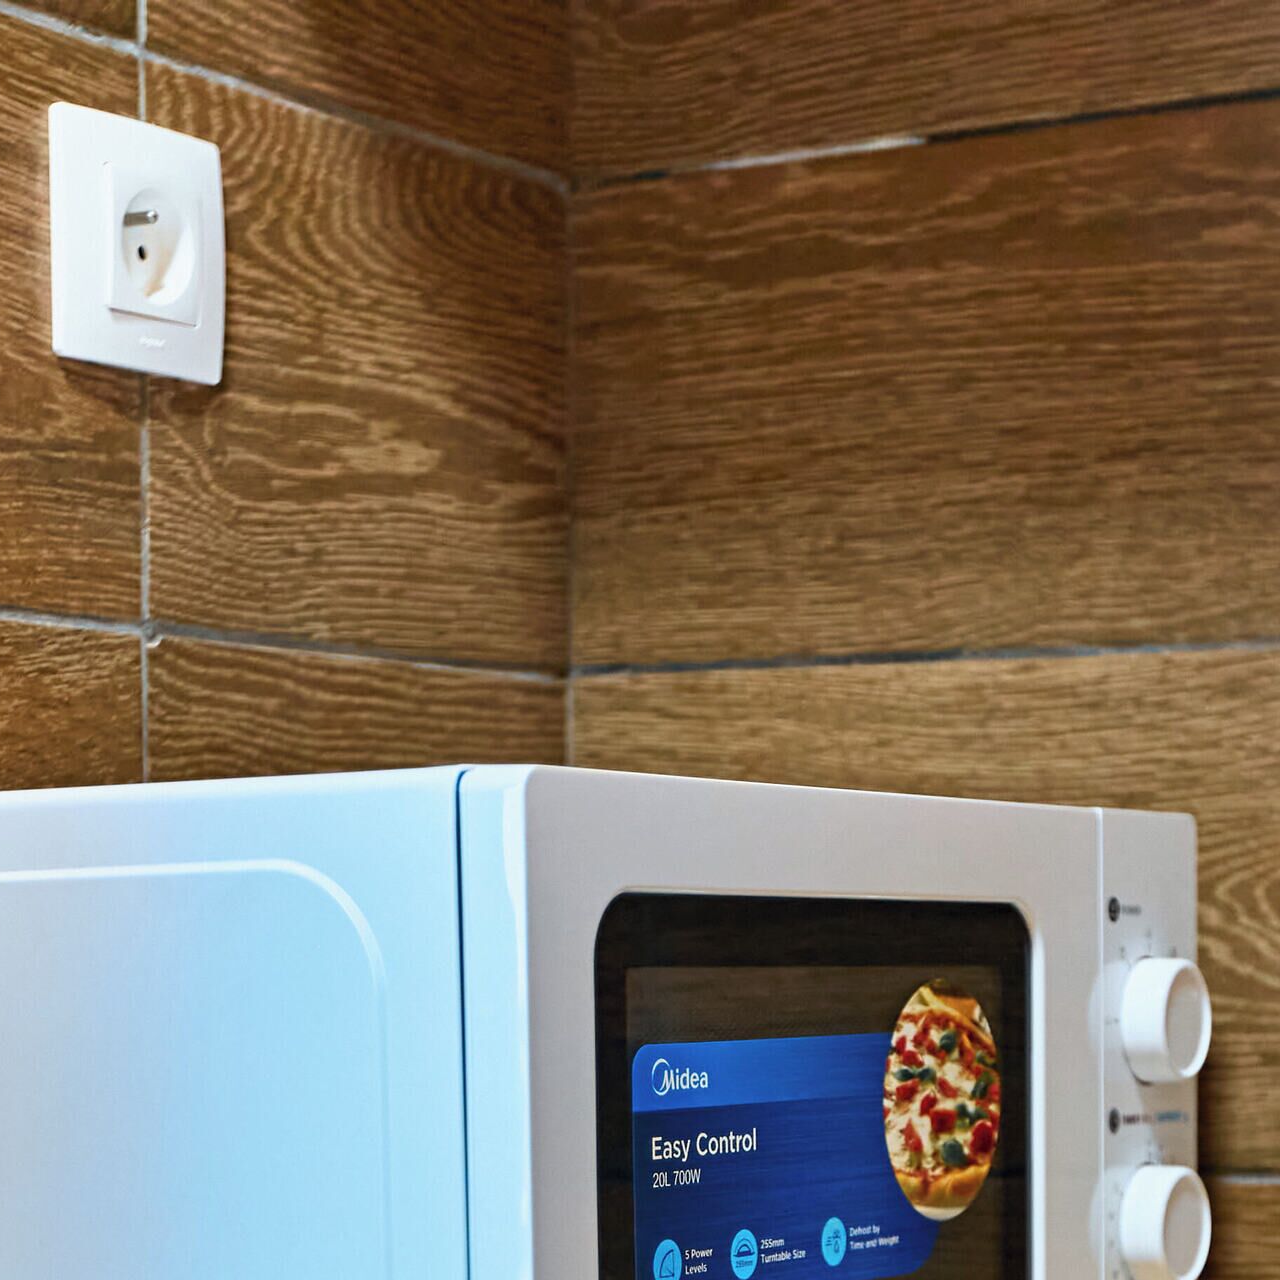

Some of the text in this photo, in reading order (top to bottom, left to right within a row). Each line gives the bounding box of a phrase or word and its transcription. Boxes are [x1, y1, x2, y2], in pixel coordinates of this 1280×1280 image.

[651, 1058, 709, 1096] Midea
[651, 1127, 757, 1162] Easy Control
[652, 1168, 701, 1188] 20L 700W
[760, 1238, 785, 1250] 255mm
[685, 1248, 713, 1260] 5 Power
[760, 1249, 807, 1264] Turntable Size
[685, 1262, 708, 1275] Levels
